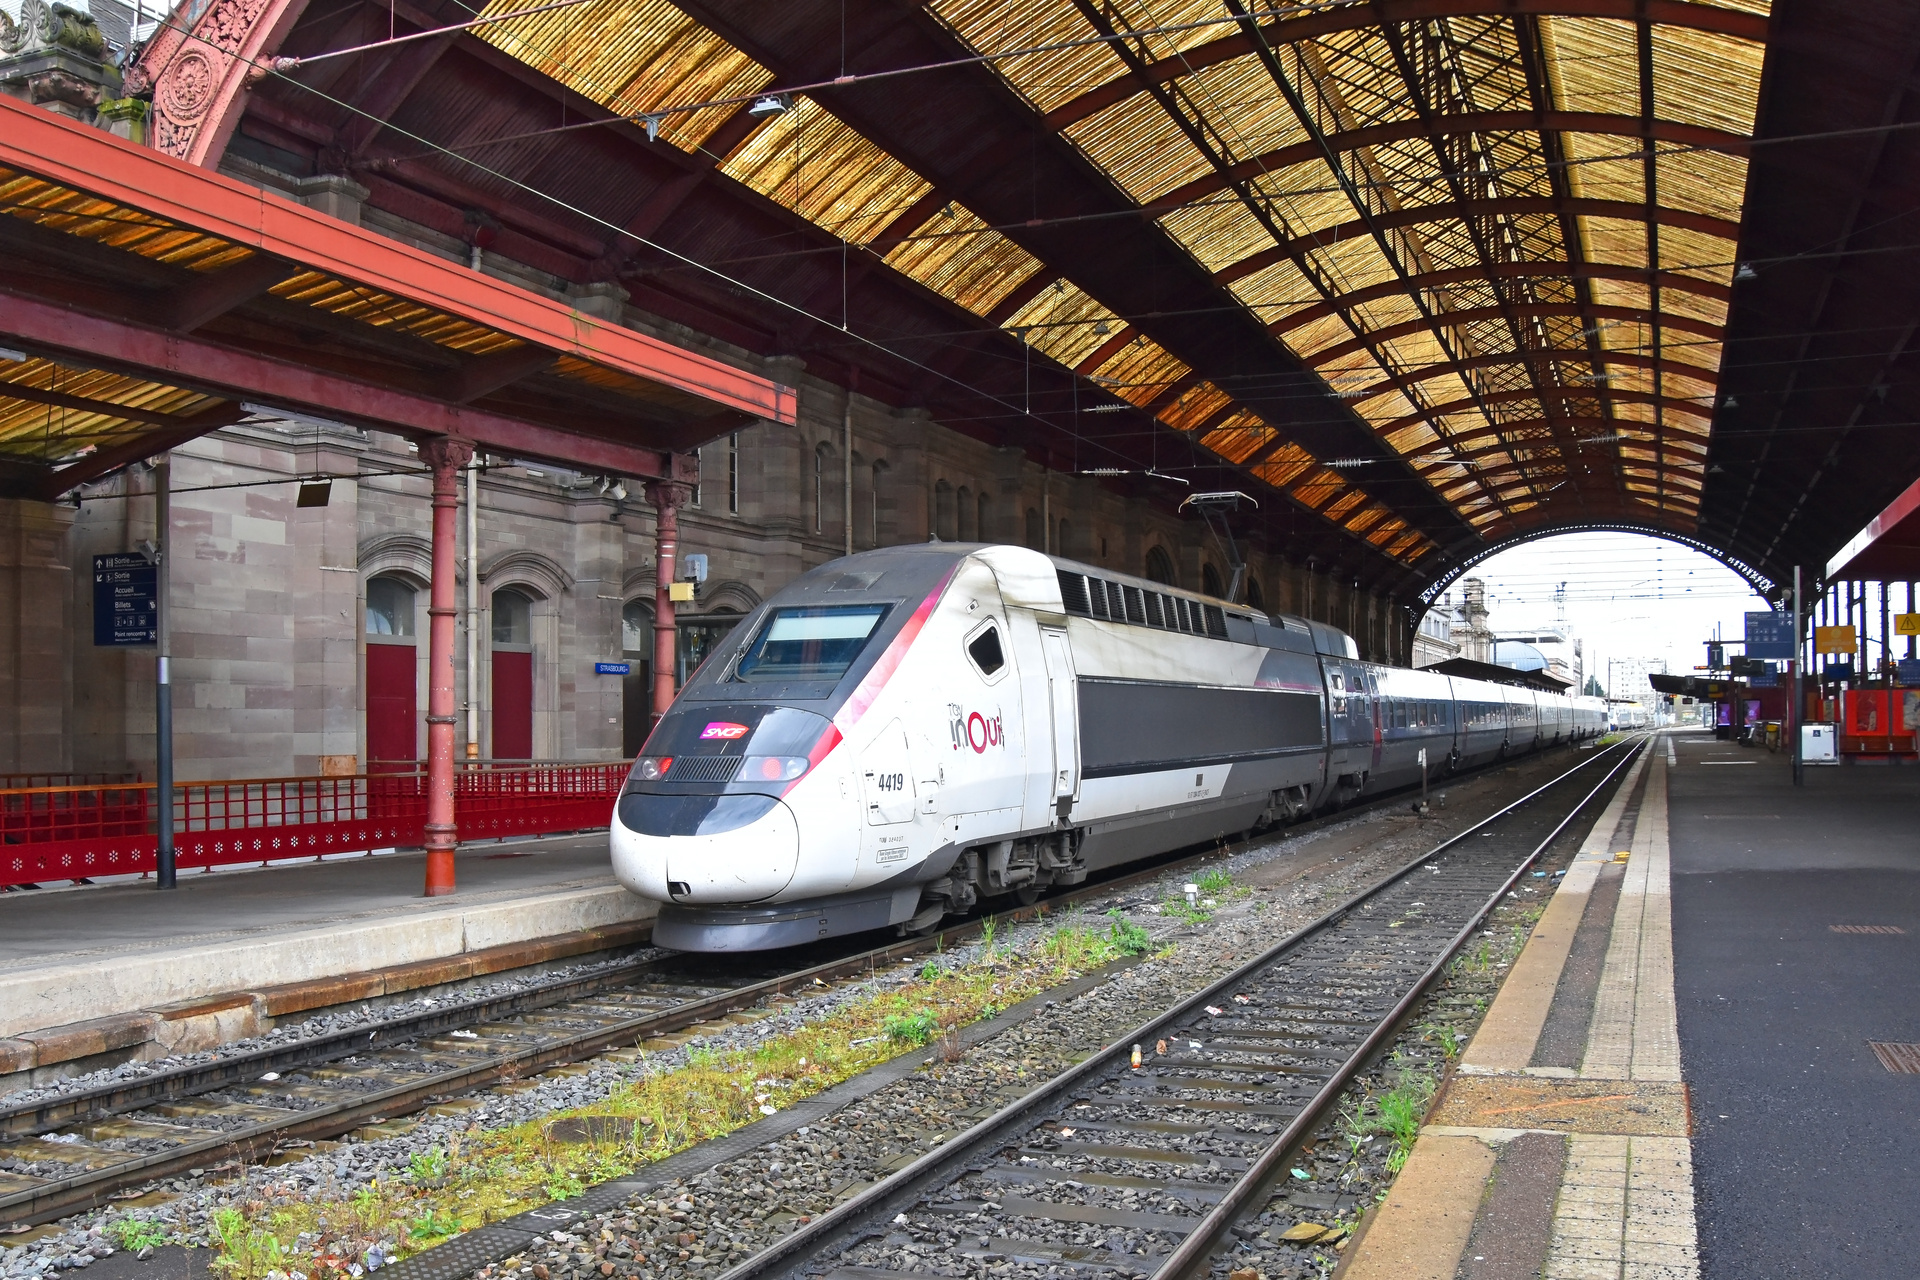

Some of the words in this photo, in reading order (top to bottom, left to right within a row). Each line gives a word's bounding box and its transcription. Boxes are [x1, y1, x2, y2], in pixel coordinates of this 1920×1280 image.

[114, 557, 130, 565] Sortie
[114, 571, 130, 579] Sortie
[114, 586, 134, 594] Accueil
[114, 601, 131, 609] Billets
[1712, 649, 1720, 661] T
[600, 664, 626, 673] STRASBOURG
[702, 727, 746, 737] SNCF
[878, 773, 904, 792] 4419
